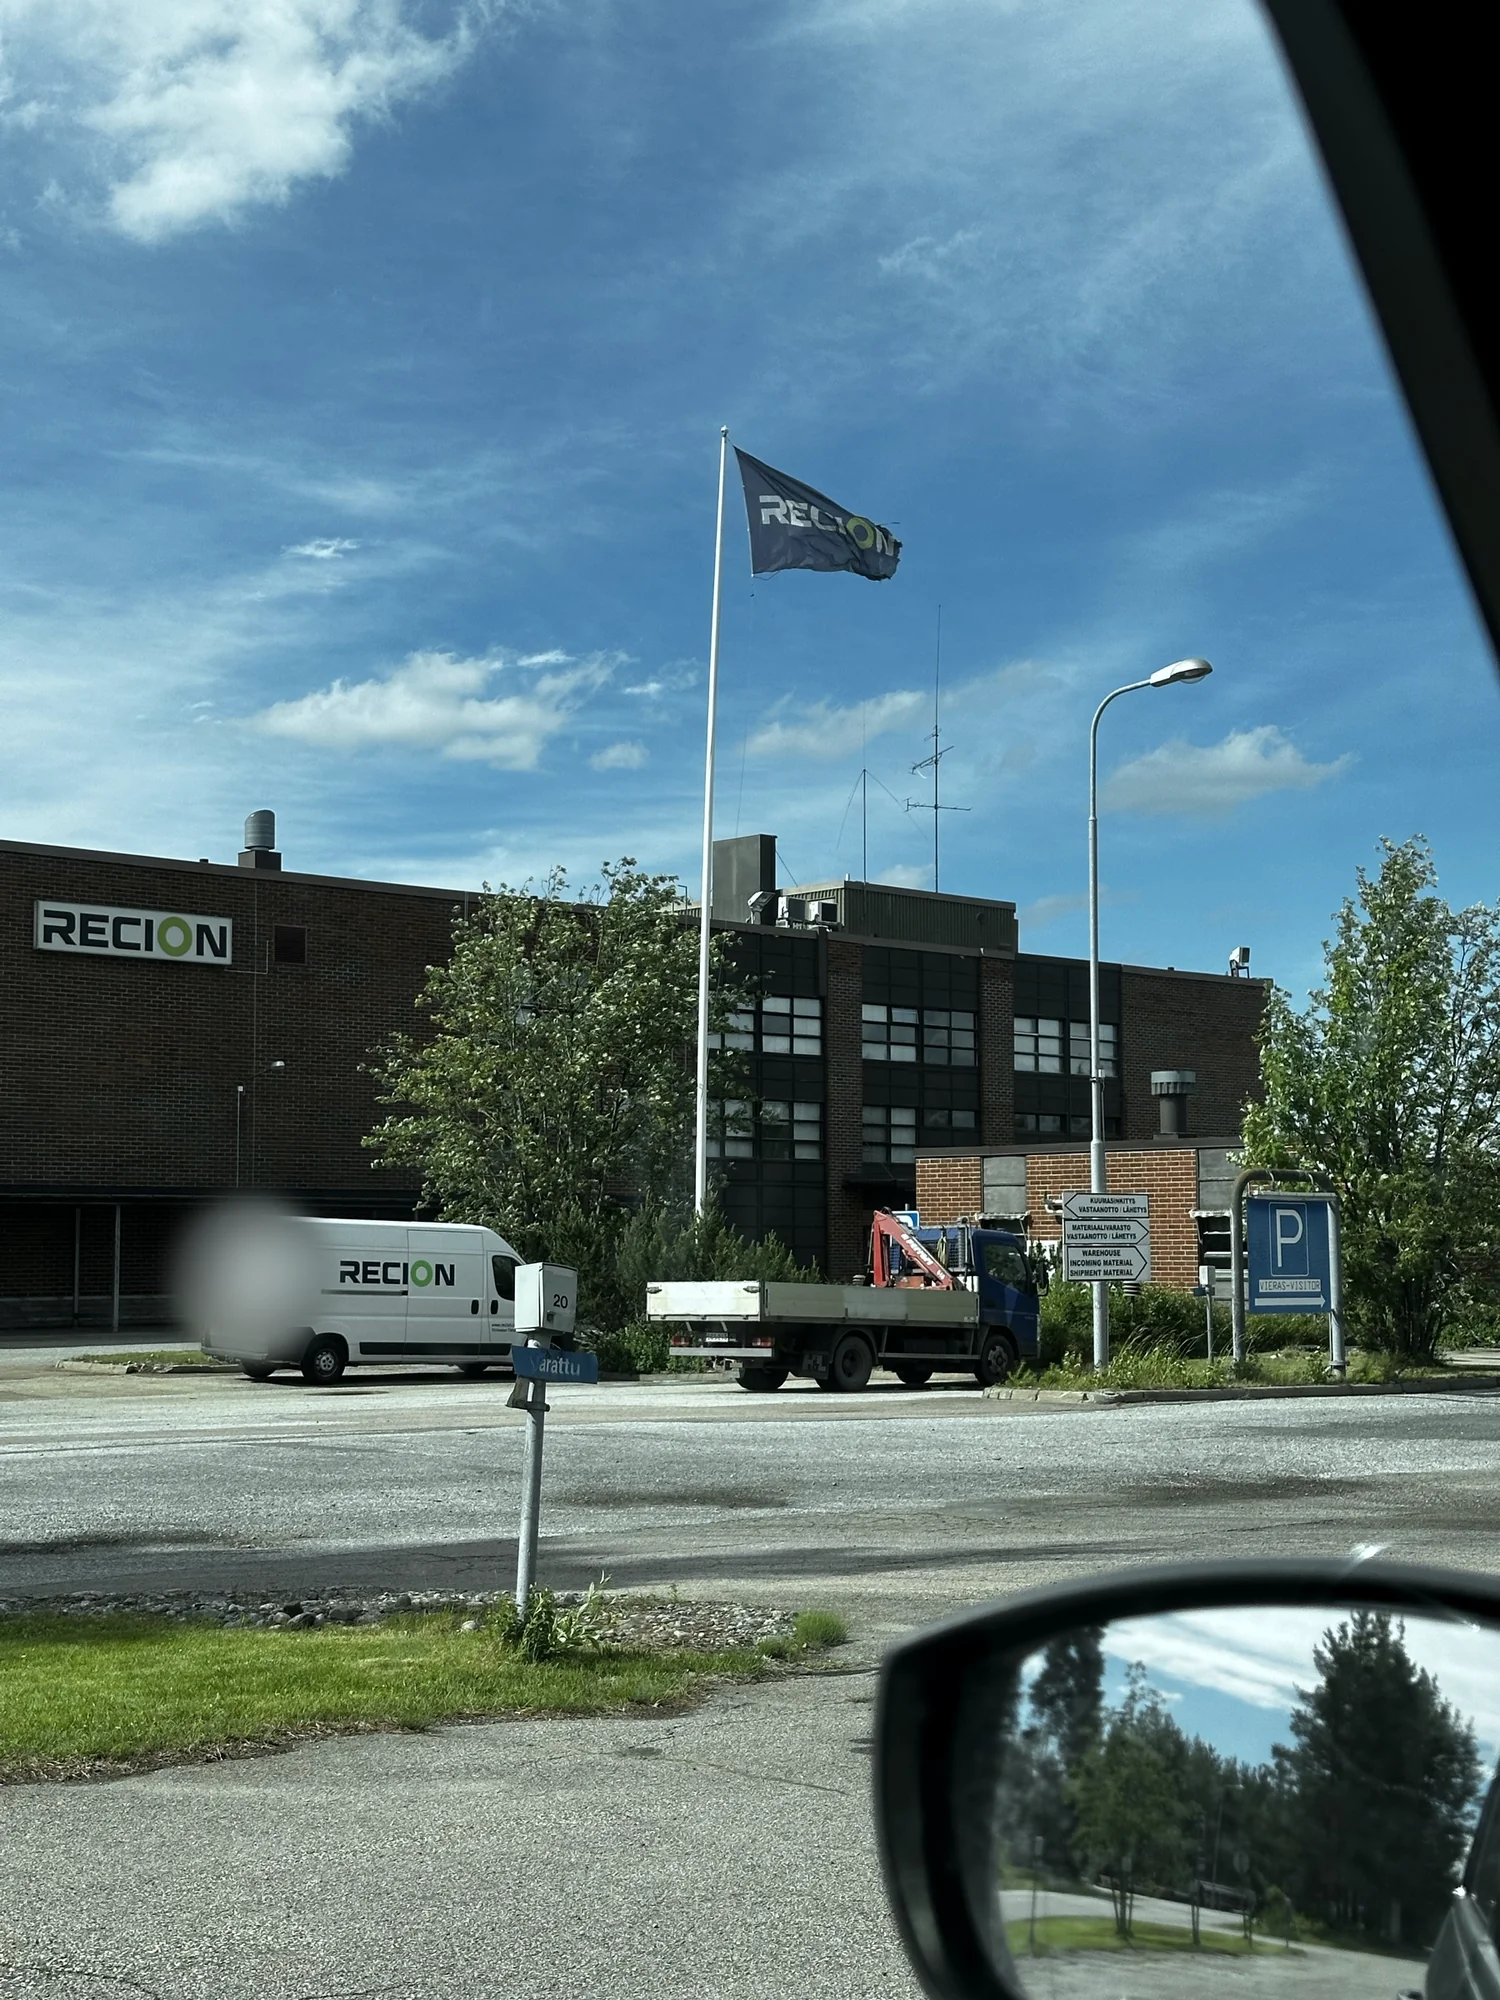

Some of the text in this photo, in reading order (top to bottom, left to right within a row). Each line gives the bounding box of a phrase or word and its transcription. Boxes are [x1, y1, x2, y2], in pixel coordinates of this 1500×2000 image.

[759, 495, 896, 557] RECION
[43, 909, 228, 958] RECION
[1090, 1197, 1136, 1205] KUUMASINKITYS
[1122, 1205, 1147, 1213] LÄHETYS
[1111, 1232, 1137, 1240] LÄHETYS
[1276, 1209, 1304, 1268] P
[1082, 1249, 1121, 1257] WAREHOUSE
[1103, 1259, 1133, 1267] MATERIAL
[340, 1260, 455, 1287] RECION
[1070, 1269, 1102, 1277] SHIPMENT
[1259, 1281, 1320, 1291] VIERAS-VISITOR
[553, 1294, 568, 1309] 20
